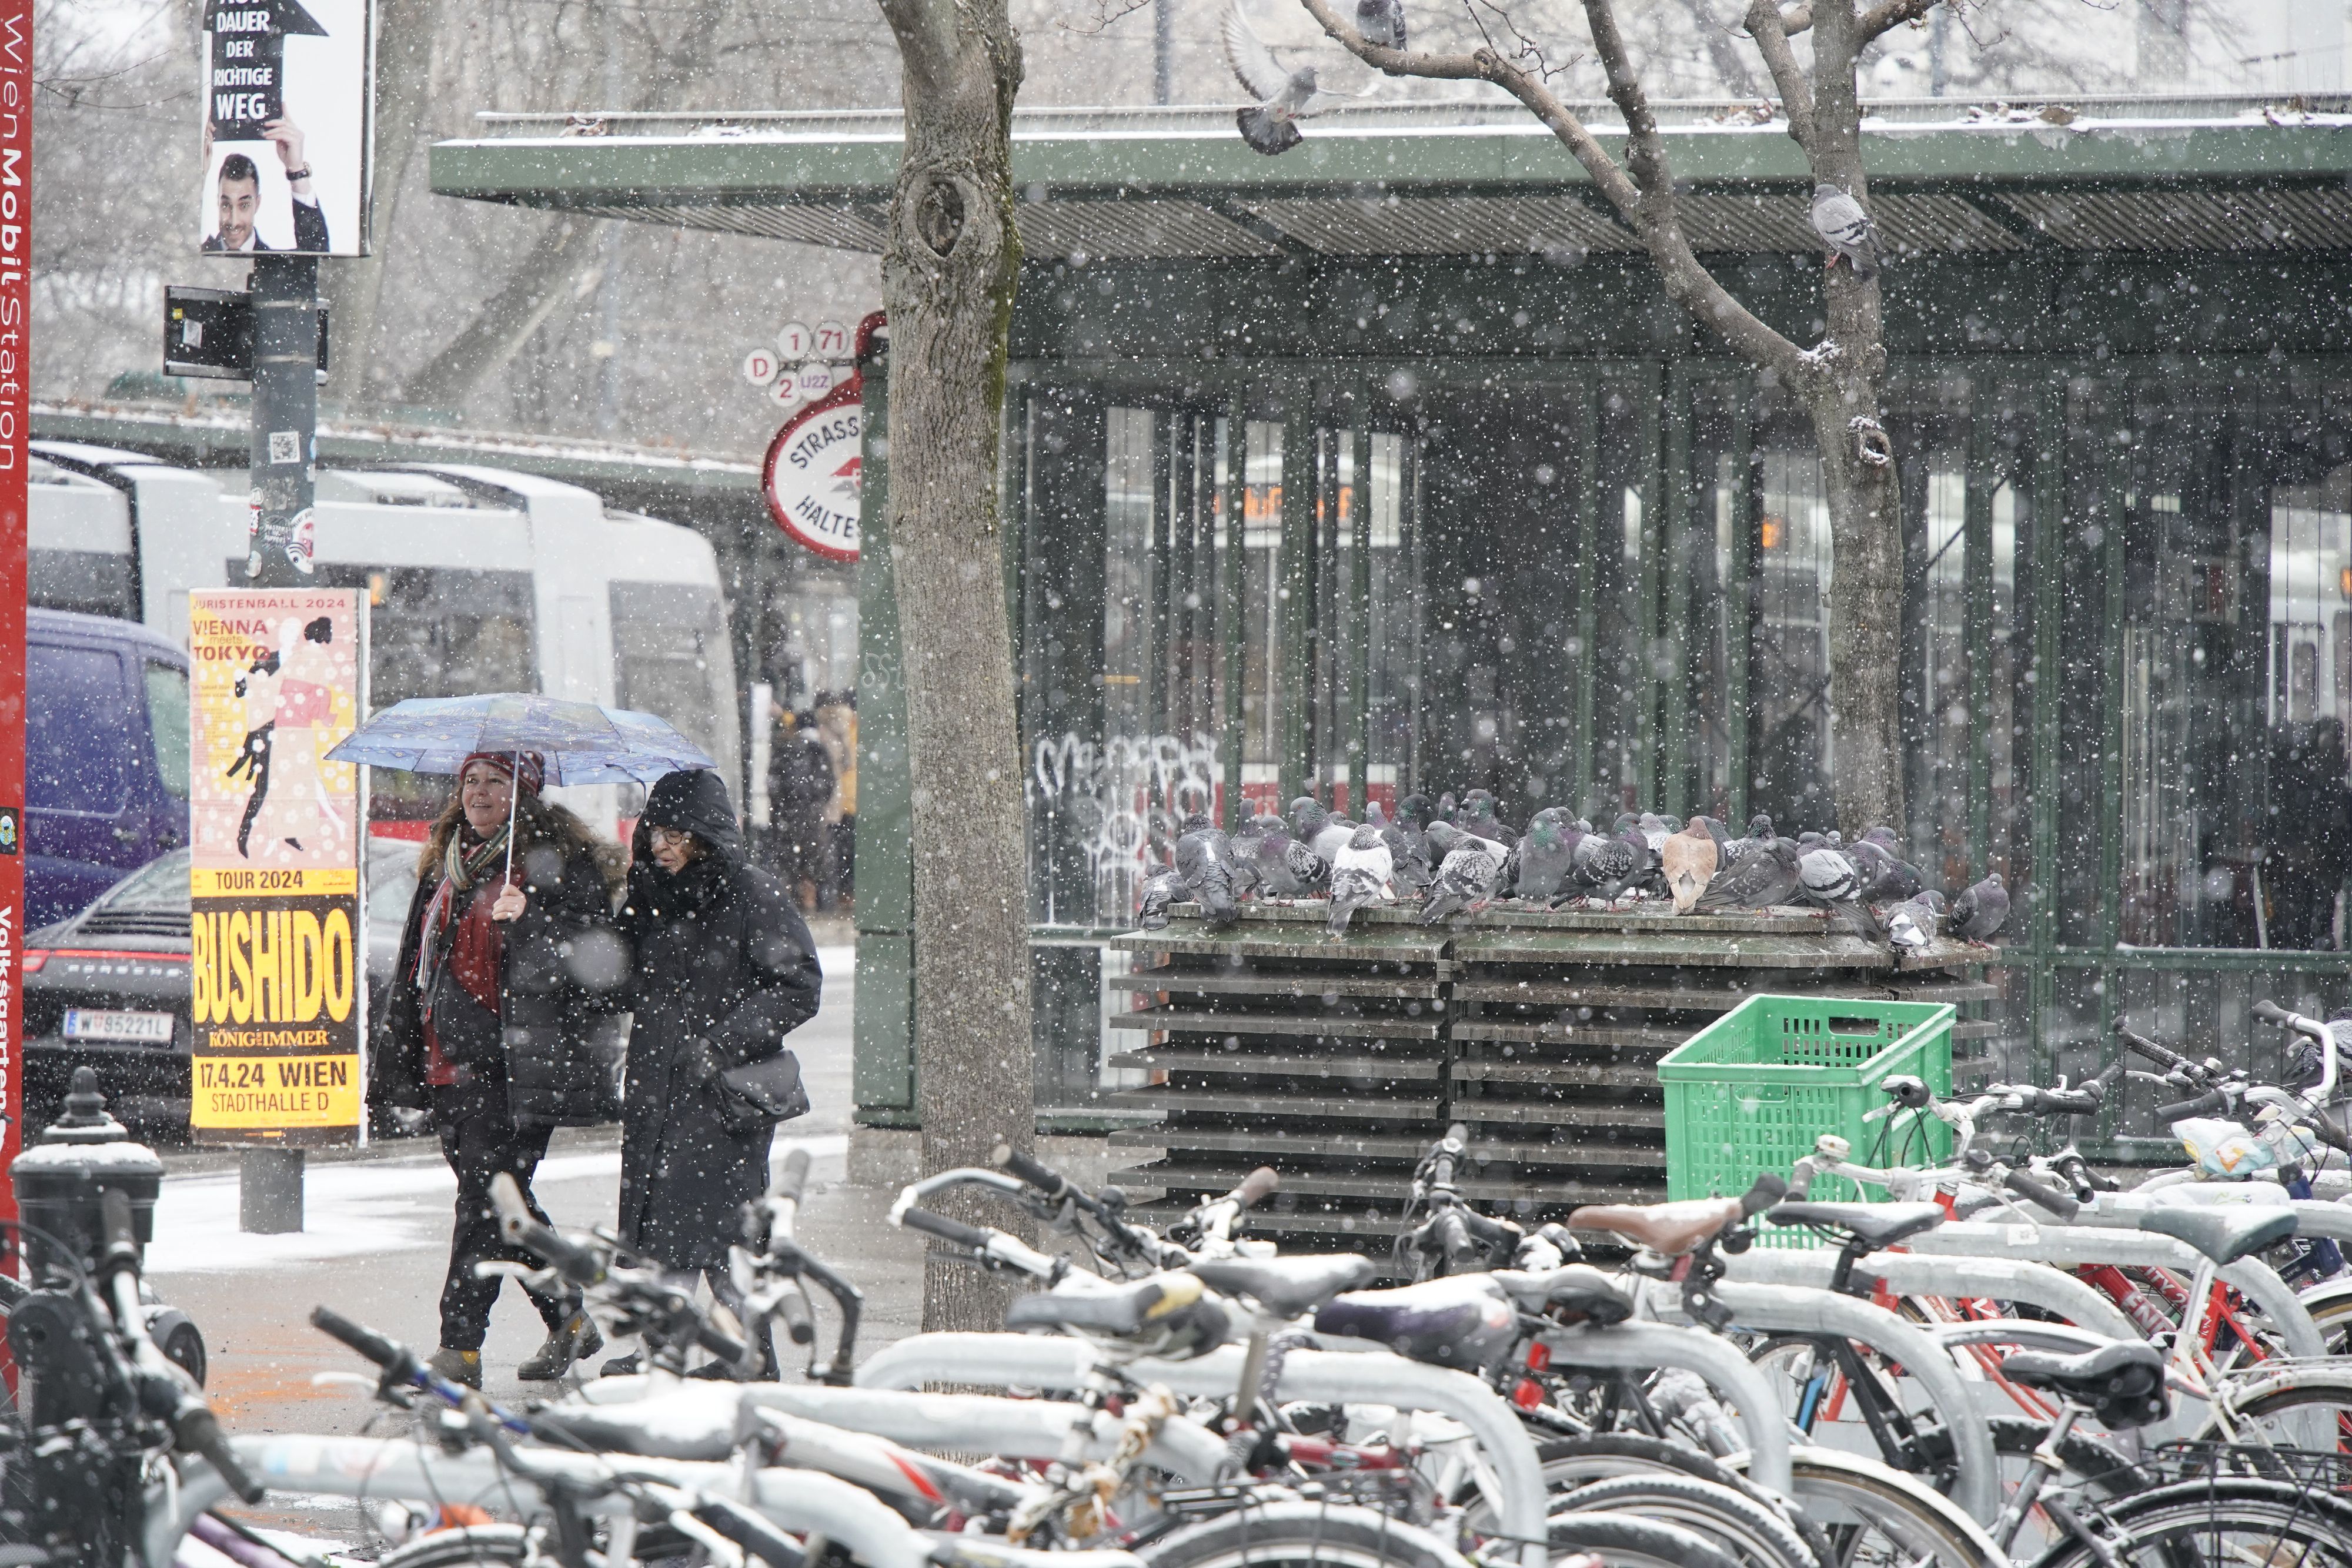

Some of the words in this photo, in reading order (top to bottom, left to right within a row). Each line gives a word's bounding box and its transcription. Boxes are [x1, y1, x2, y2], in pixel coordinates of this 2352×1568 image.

[216, 11, 270, 33] DAUER
[226, 41, 254, 58] DER
[214, 68, 273, 86] RICHTIGE
[216, 92, 266, 121] WEG
[790, 332, 799, 351] 1
[820, 330, 843, 350] 71
[753, 358, 769, 377] D
[780, 379, 793, 398] 2
[801, 375, 830, 389] U2Z
[796, 495, 861, 539] HALTE
[193, 599, 299, 609] JURISTENBALL
[306, 599, 346, 609] 2024
[193, 619, 268, 635] VIENNA
[209, 636, 243, 644] meets
[194, 646, 271, 661] TOKYO
[215, 871, 255, 890] TOUR
[260, 870, 303, 888] 2024
[192, 908, 353, 1025] BUSHIDO
[81, 1014, 92, 1031] W
[209, 1029, 256, 1048] KÖNIG
[263, 1030, 329, 1047] IMMER
[200, 1063, 265, 1088] 17.4.24
[279, 1061, 346, 1087] WIEN
[212, 1092, 310, 1112] STADTHALLE
[318, 1092, 329, 1110] D
